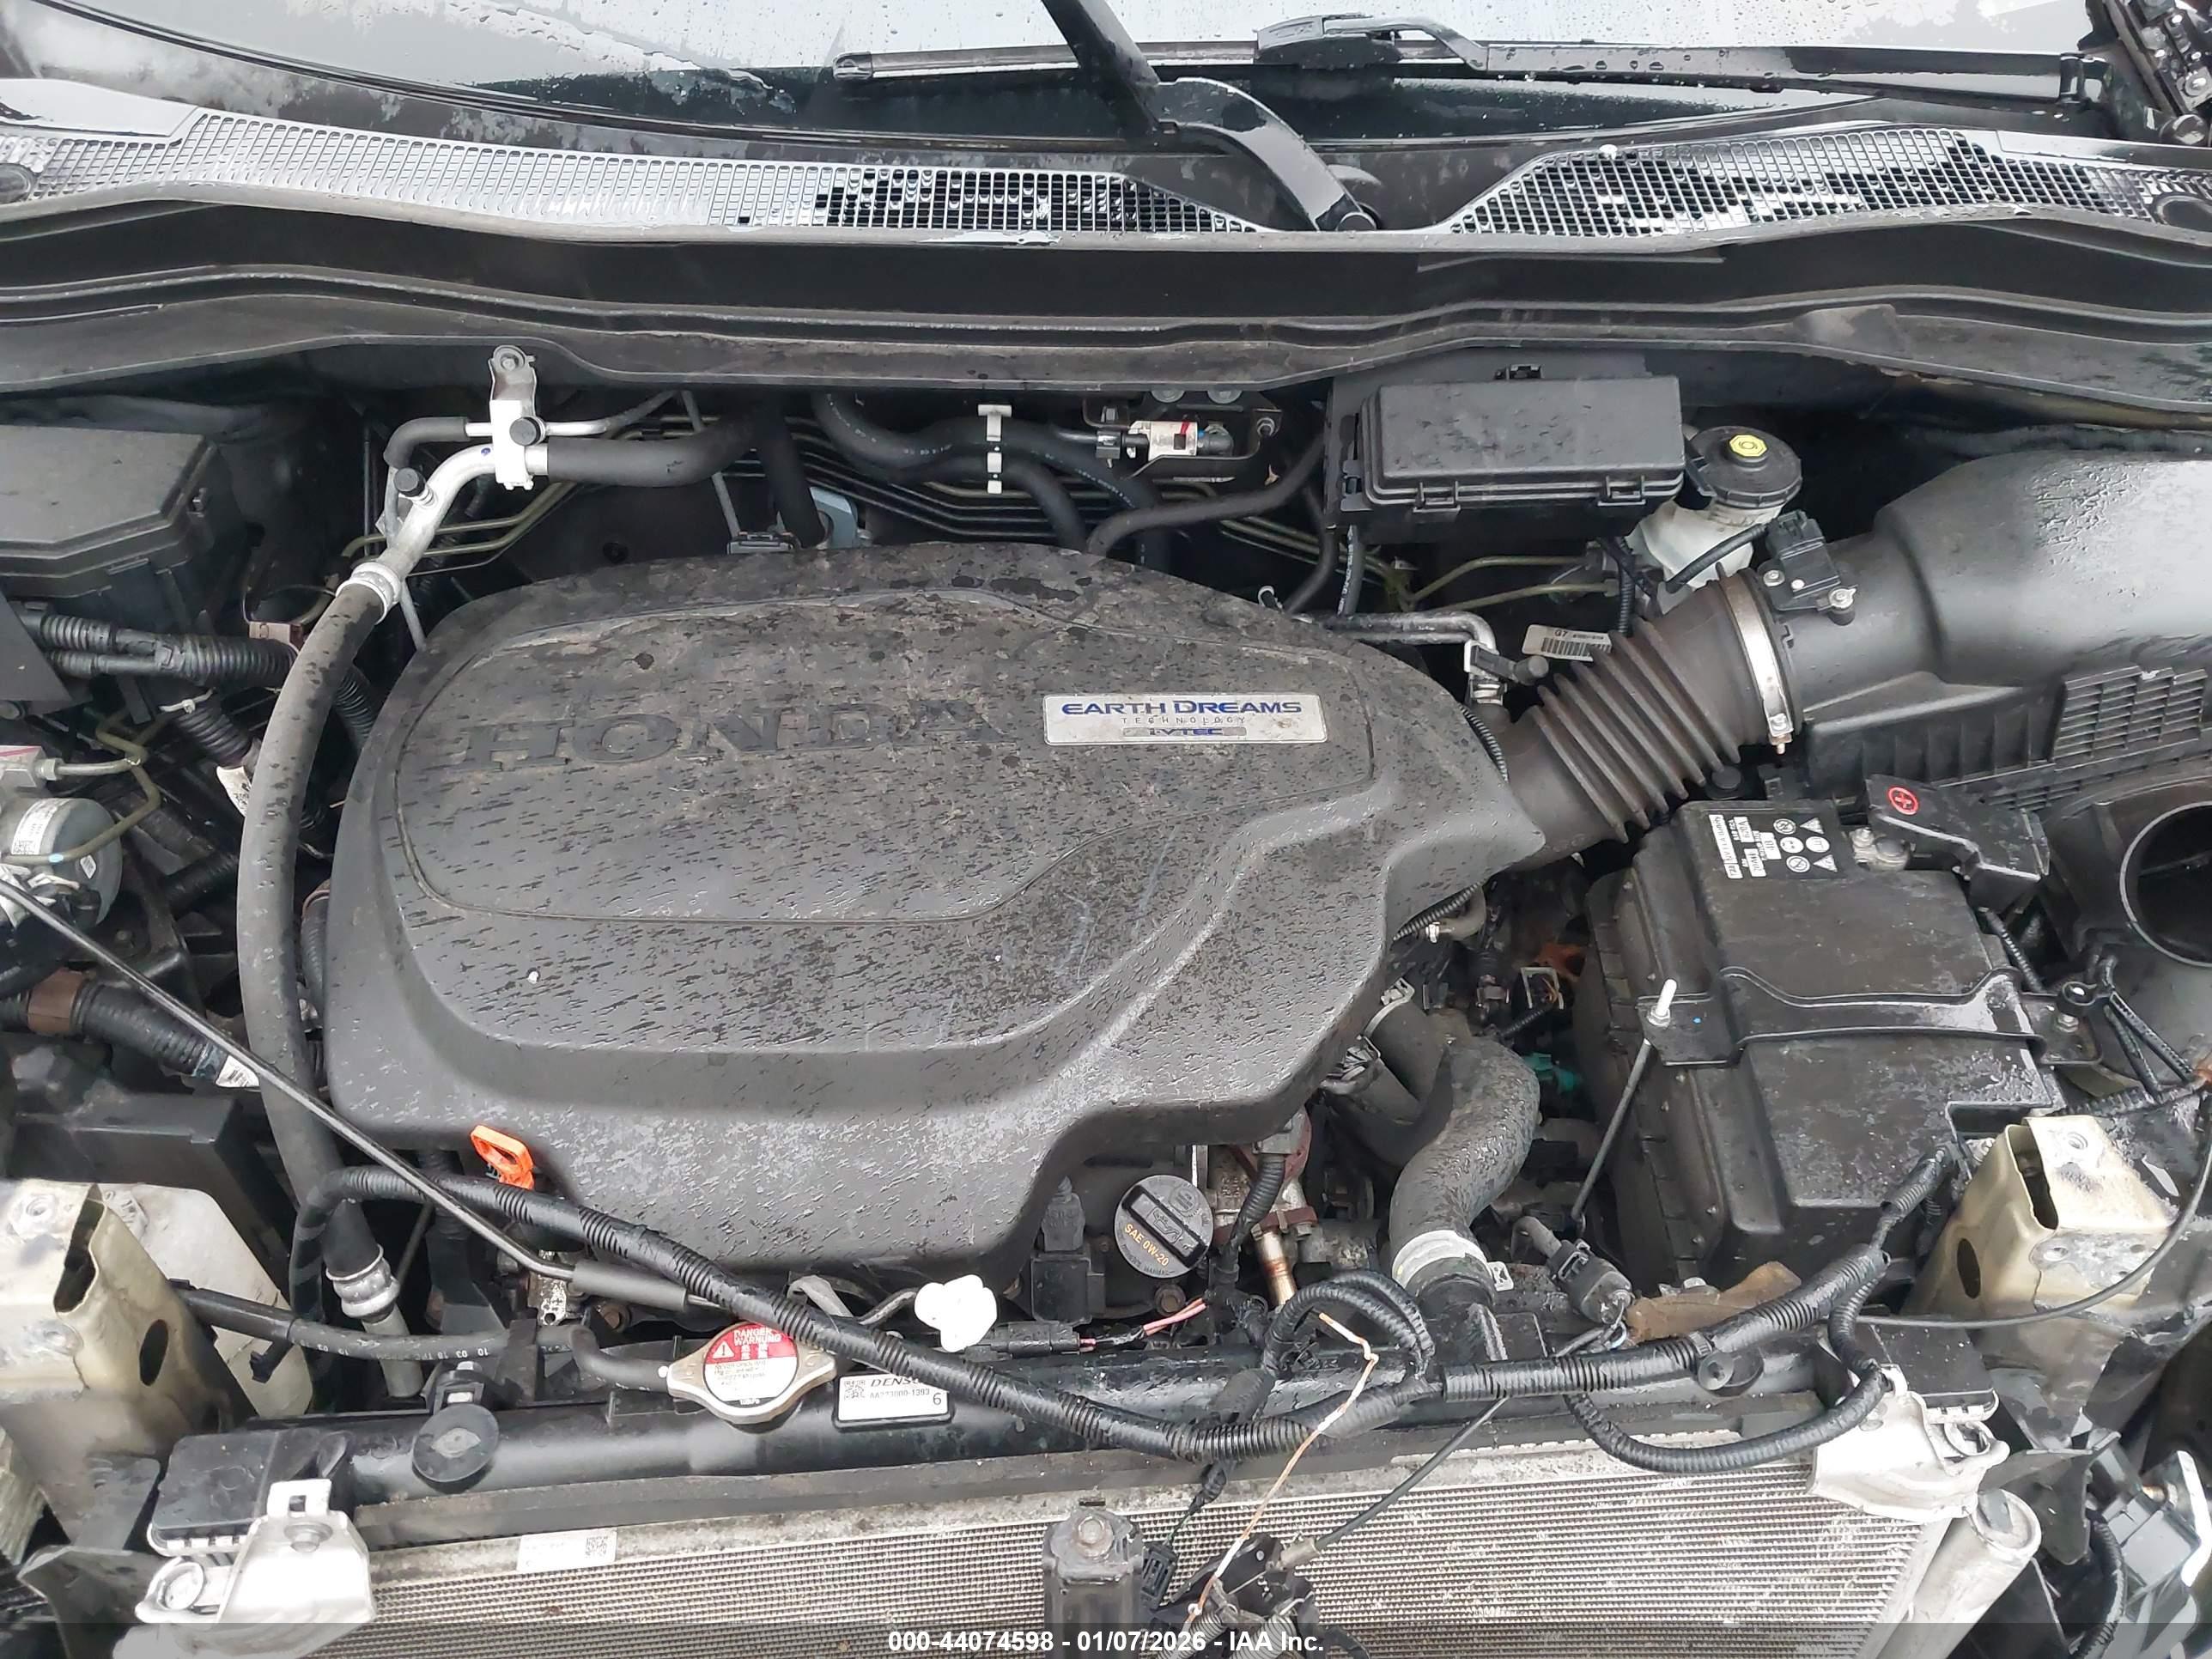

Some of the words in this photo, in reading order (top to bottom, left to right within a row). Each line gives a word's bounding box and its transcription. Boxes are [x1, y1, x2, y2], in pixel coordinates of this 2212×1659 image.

[1061, 702, 1166, 715] EARTH
[1174, 699, 1302, 715] DREAMS
[1121, 716, 1245, 726] TECHNOLOGY
[442, 699, 1017, 773] HONDA
[1124, 1223, 1145, 1244] SAE
[1142, 1240, 1170, 1267] 0W-20
[477, 1347, 489, 1357] 10
[933, 1392, 942, 1406] 6
